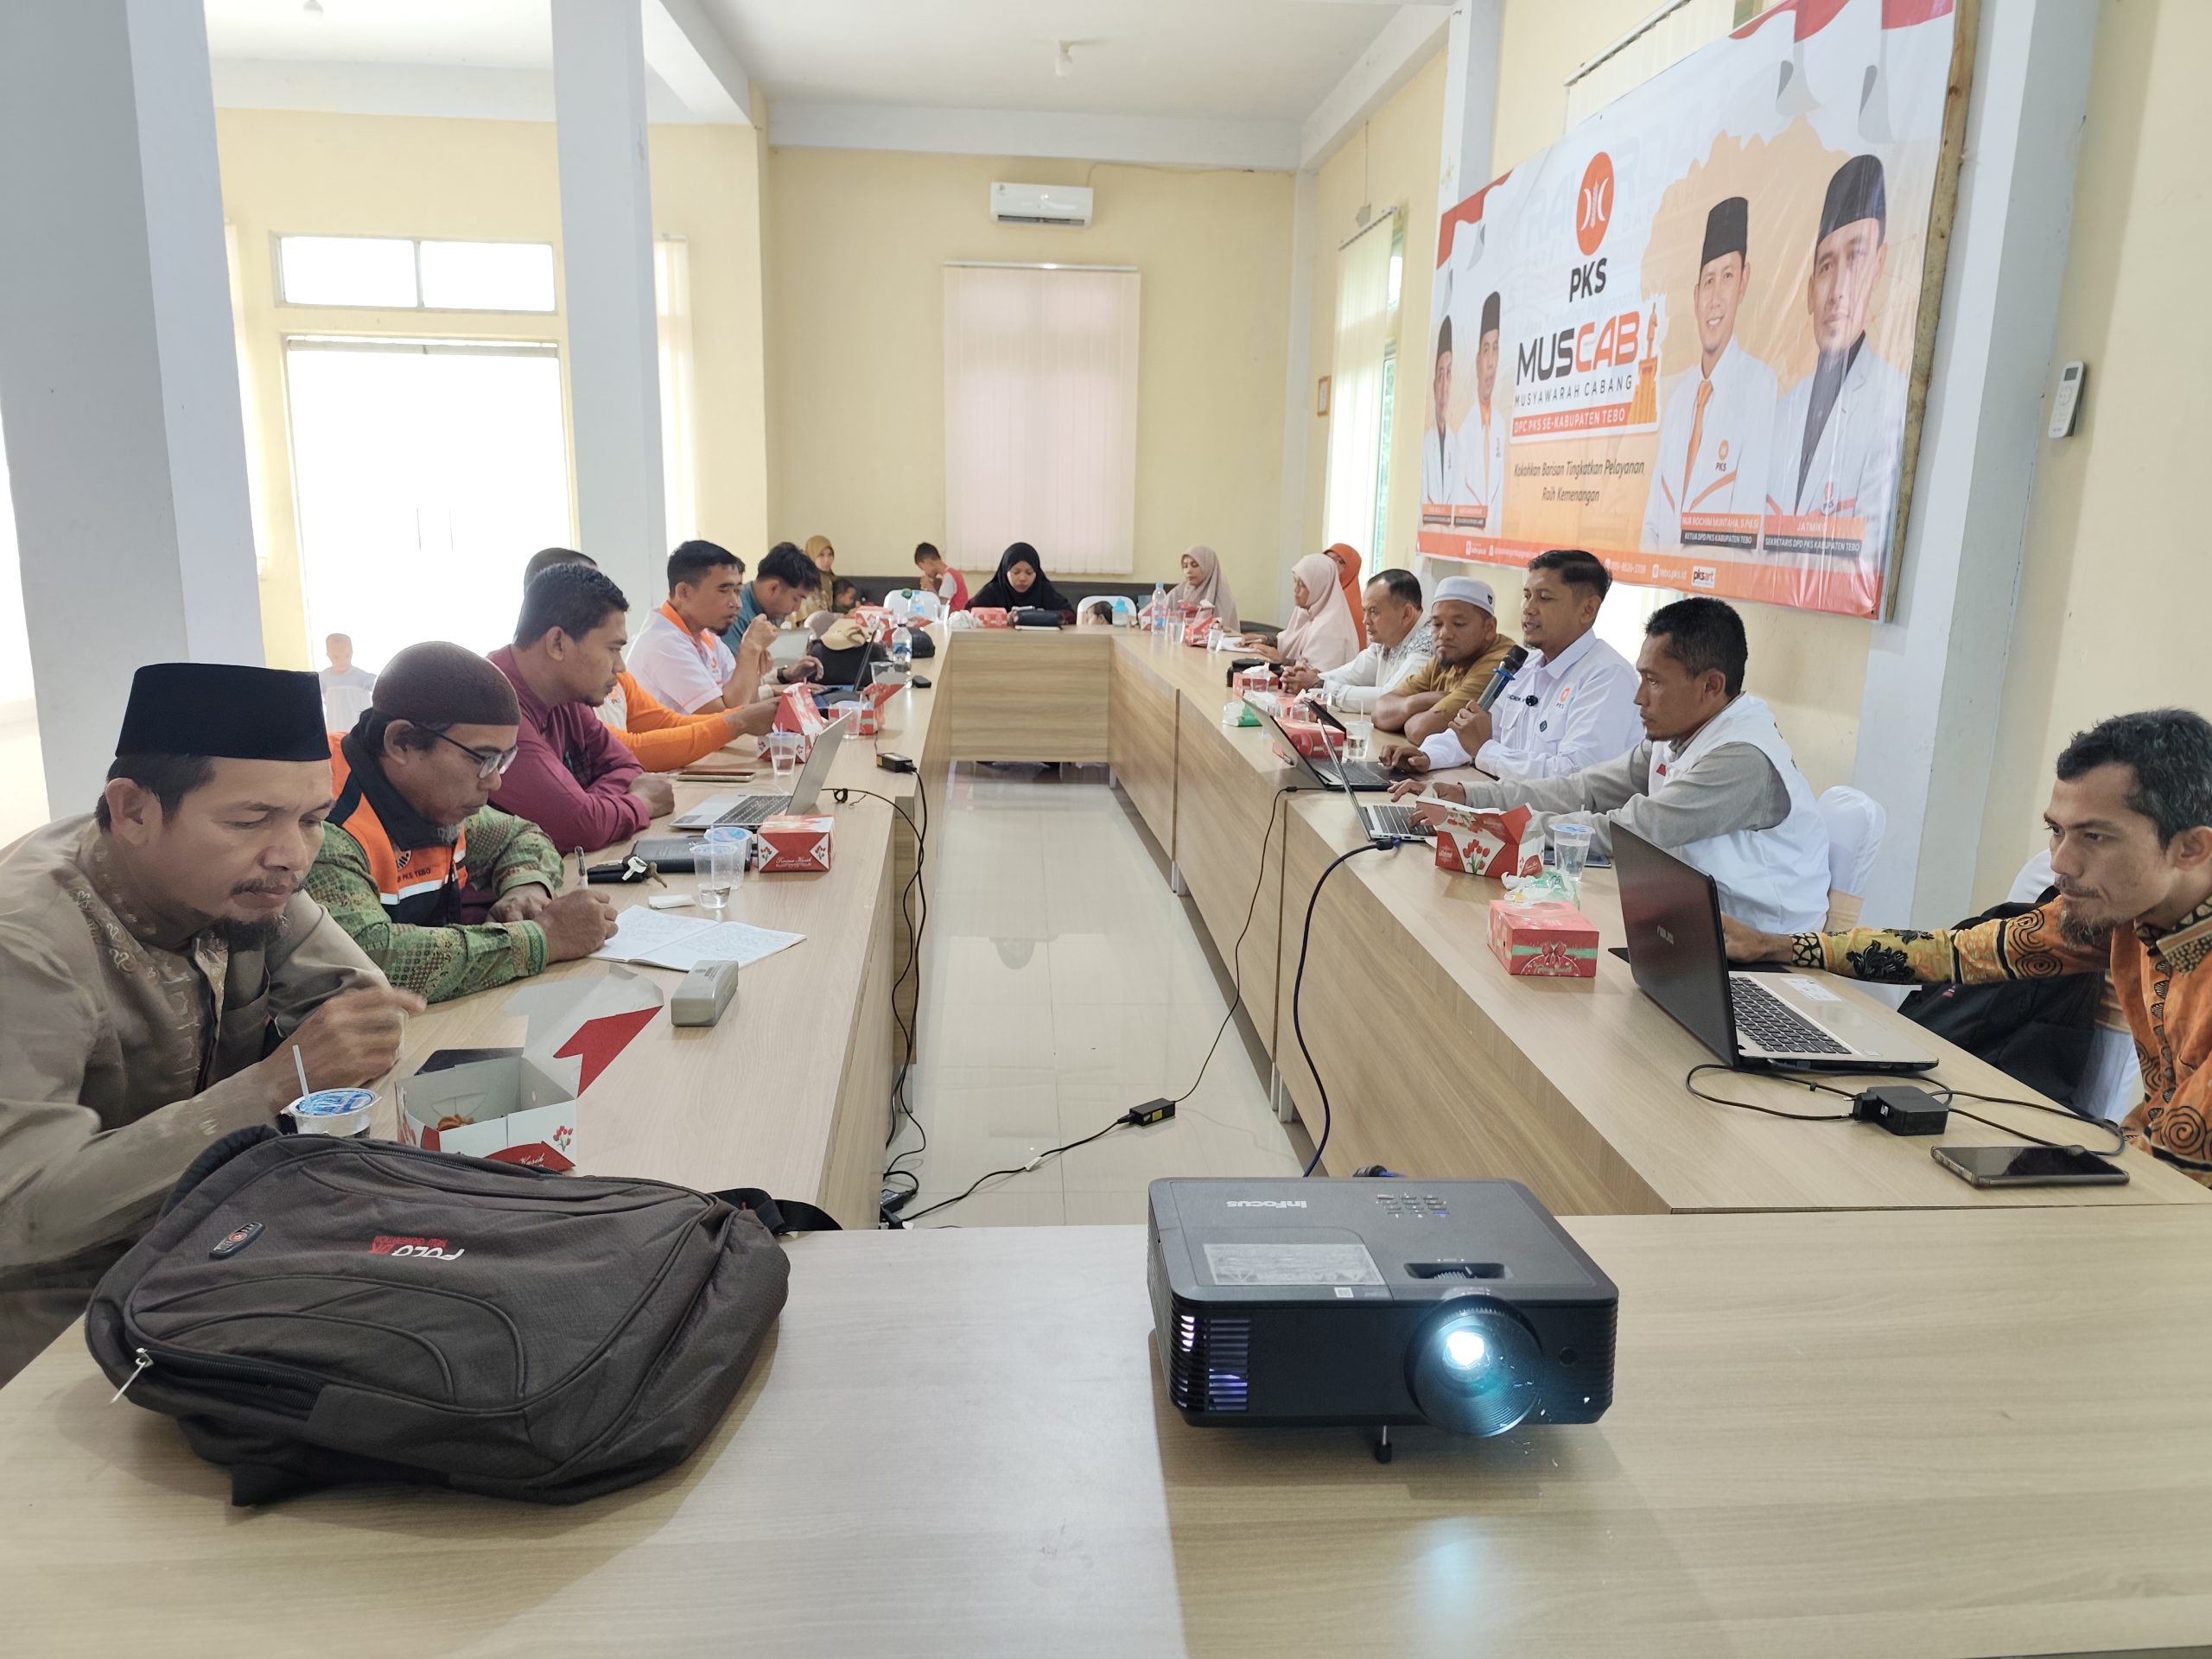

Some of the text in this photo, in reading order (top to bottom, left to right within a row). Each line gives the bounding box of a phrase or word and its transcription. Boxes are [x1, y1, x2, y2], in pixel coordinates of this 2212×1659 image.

[1569, 257, 1607, 302] PKS
[1516, 311, 1640, 385] MUSCAB
[1515, 374, 1632, 408] MUSYAWARAH CABANG
[1514, 408, 1625, 433] DPC PKS SE-KABUPATEN TEBO
[1541, 461, 1565, 477] Barisan
[1566, 461, 1604, 480] Tingkatkan
[1604, 458, 1645, 479] Pelayanan
[1715, 462, 1726, 472] PKS
[1542, 486, 1600, 506] Raih Kemenangan
[1715, 534, 1739, 543] KABUPATEN
[1740, 536, 1752, 544] TEBO
[1764, 537, 1792, 547] SEKRETARIS
[1793, 539, 1803, 548] DPD
[1803, 540, 1814, 549] PKS
[1846, 543, 1860, 552] TEBO
[415, 868, 431, 878] TEBO
[391, 1244, 465, 1261] POLO
